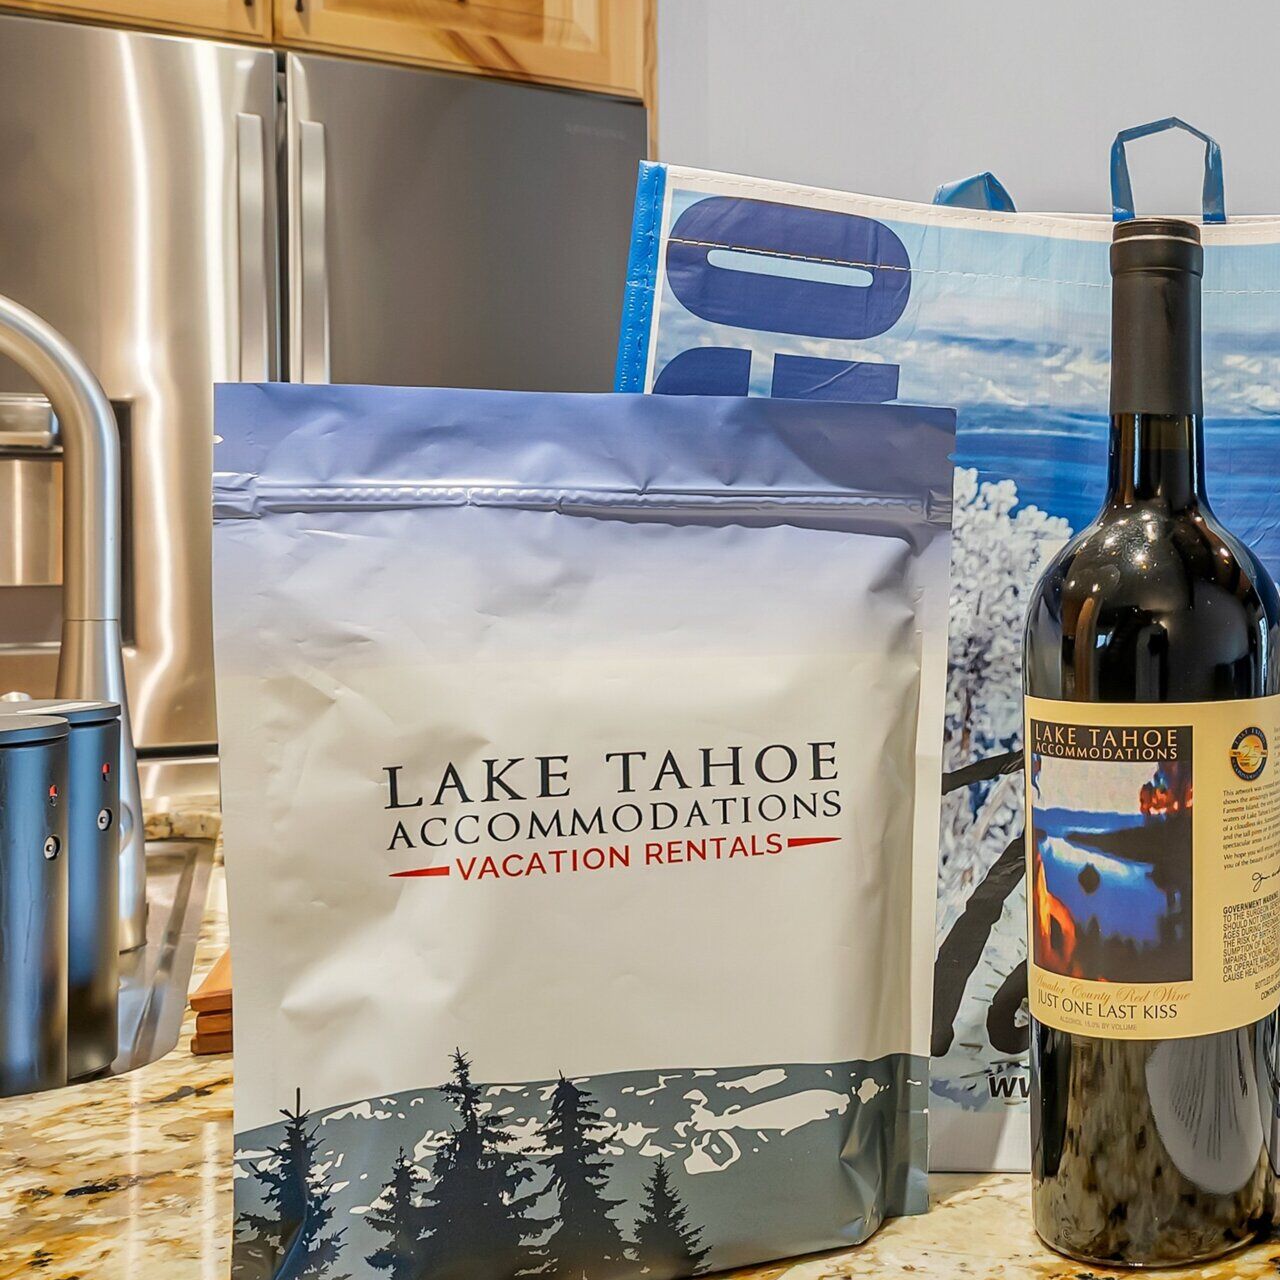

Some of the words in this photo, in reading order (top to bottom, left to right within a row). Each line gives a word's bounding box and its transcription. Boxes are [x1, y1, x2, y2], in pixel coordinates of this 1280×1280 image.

[1035, 723, 1077, 745] LAKE
[1088, 728, 1178, 747] TAHOE
[1035, 742, 1178, 760] ACCOMMODATIONS
[382, 754, 572, 810] LAKE
[605, 741, 839, 794] TAHOE
[386, 790, 842, 851] ACCOMMODATIONS
[456, 844, 628, 881] VACATION
[644, 832, 783, 866] RENTALS
[1223, 898, 1262, 914] GOVERNMENT
[1233, 911, 1245, 921] THE
[1223, 919, 1248, 932] SHOULD
[1223, 930, 1240, 940] AGES
[1223, 939, 1235, 948] THE
[1236, 935, 1250, 945] RISK
[1223, 943, 1253, 957] SUMPTION
[1223, 952, 1247, 964] IMPAIRS
[1223, 971, 1244, 983] CAUSE
[1066, 980, 1112, 1006] County
[1116, 985, 1150, 1002] Red
[1153, 983, 1190, 1002] Wine
[1038, 989, 1059, 1009] JUST
[1062, 998, 1093, 1016] ONE
[1098, 1004, 1138, 1019] LAST
[1143, 1004, 1178, 1019] KISS
[1101, 1022, 1110, 1030] BY
[1112, 1023, 1137, 1031] VOLUME
